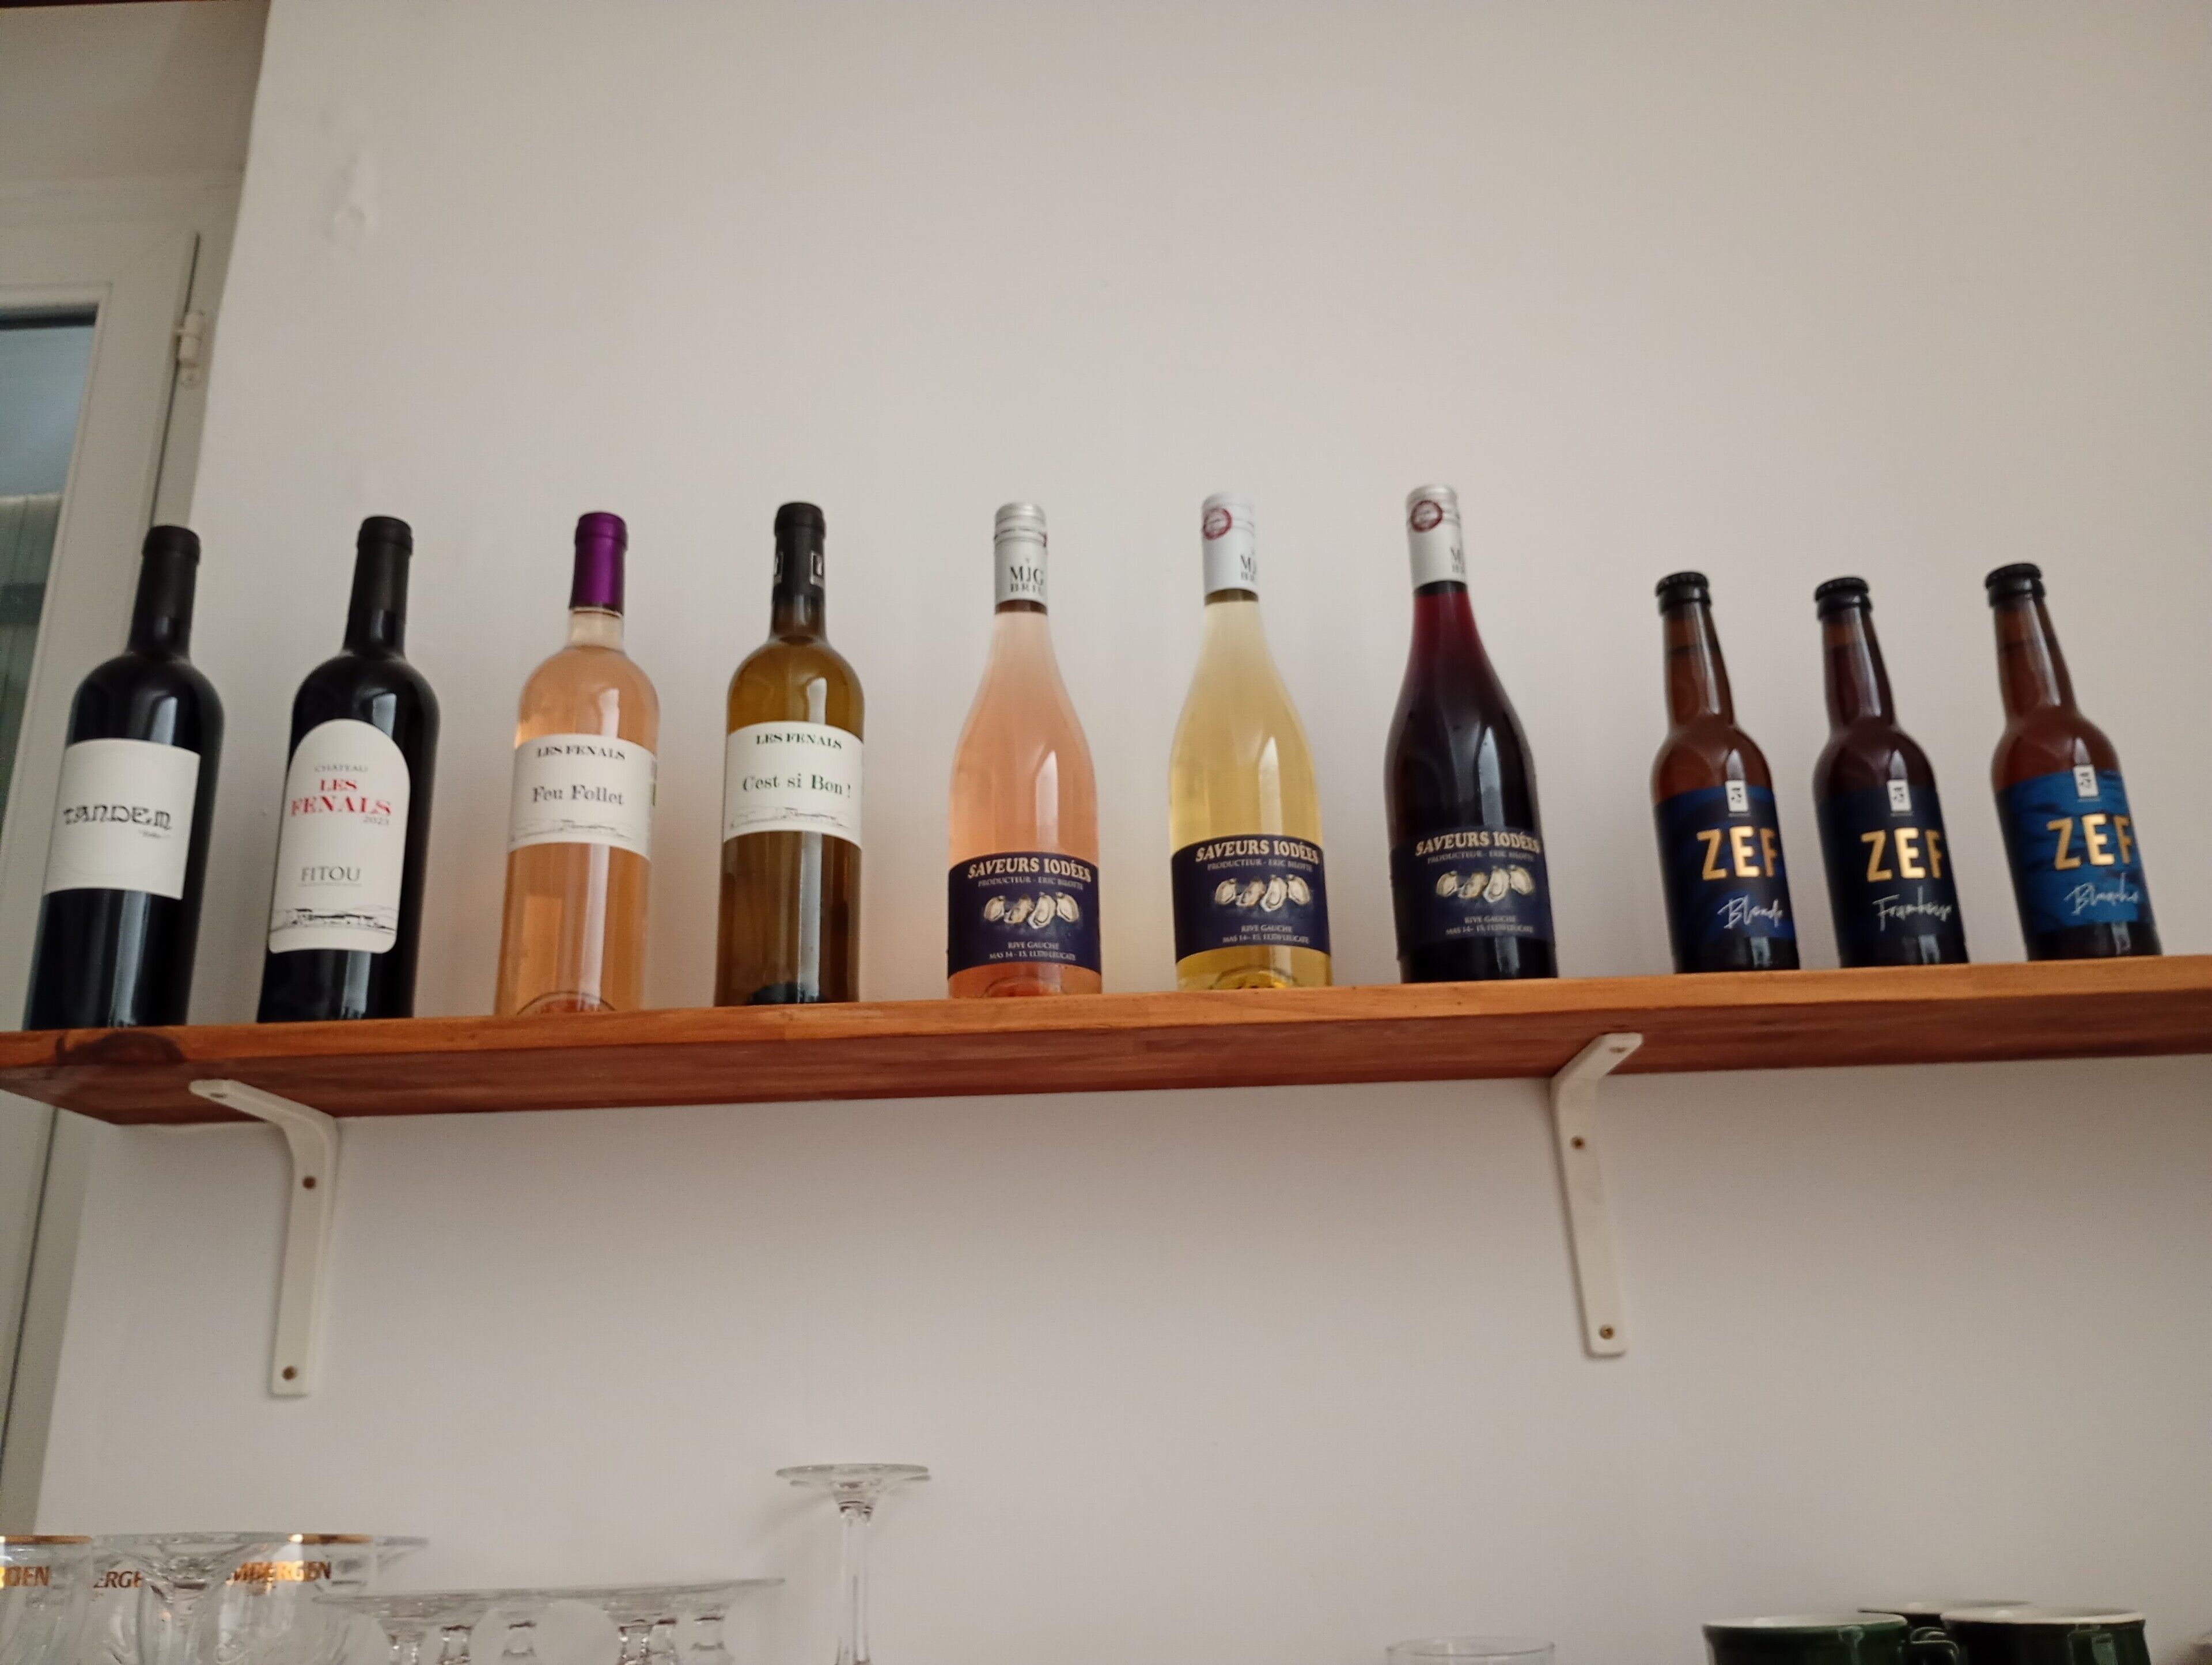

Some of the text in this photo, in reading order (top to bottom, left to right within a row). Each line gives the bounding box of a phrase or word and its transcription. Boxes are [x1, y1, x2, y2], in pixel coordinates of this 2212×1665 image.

[756, 733, 842, 749] LES FENALS
[537, 745, 625, 760] LES FENALS
[320, 779, 357, 791] LES
[787, 773, 802, 788] si
[571, 784, 625, 805] Follet
[291, 795, 391, 817] FENALS
[1195, 839, 1270, 863] SAVEURS
[1415, 831, 1490, 857] SAVEURS
[1696, 825, 1778, 880] ZEF
[2046, 813, 2131, 870] ZEF
[1861, 827, 1943, 882] ZEF
[301, 866, 361, 882] FITOU
[967, 857, 1039, 879] SAVEURS
